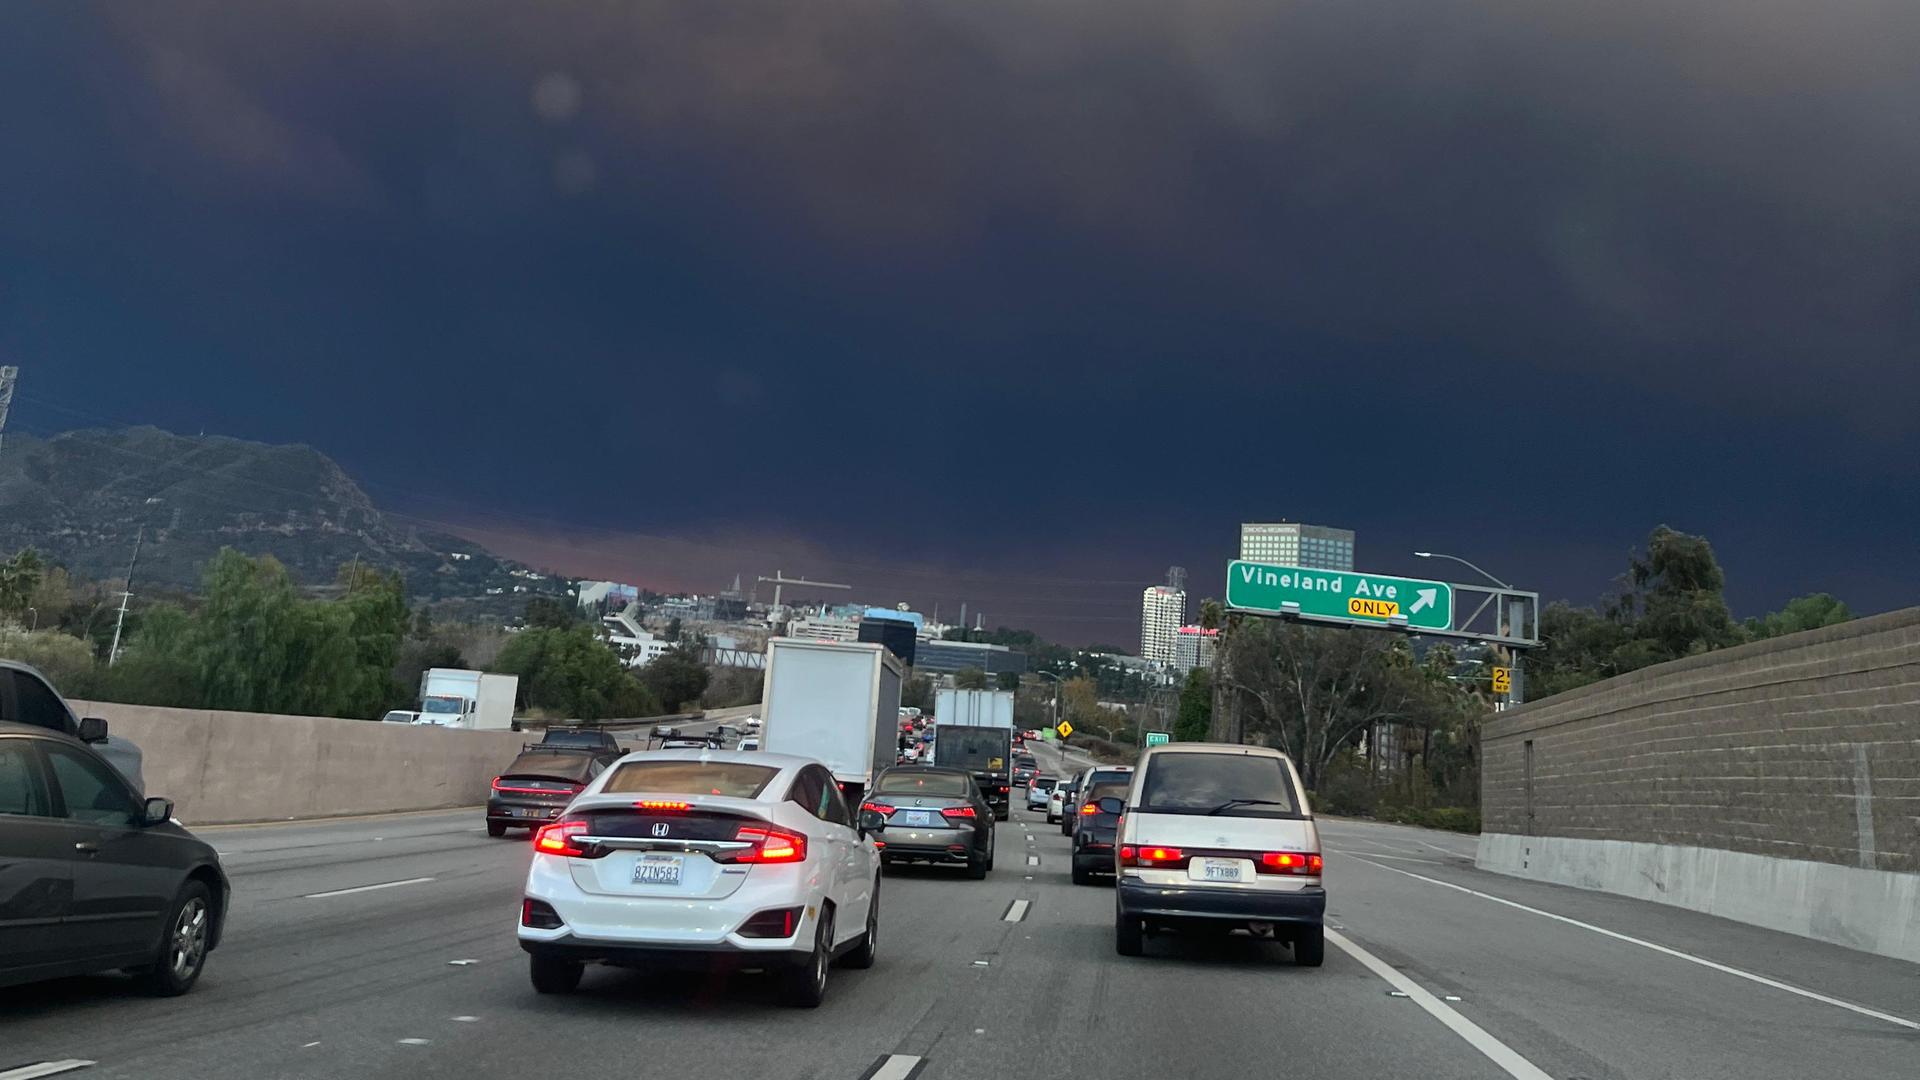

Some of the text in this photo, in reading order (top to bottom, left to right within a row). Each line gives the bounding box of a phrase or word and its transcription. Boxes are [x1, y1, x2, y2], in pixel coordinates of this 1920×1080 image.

[1241, 566, 1398, 599] Vineland Ave
[1350, 600, 1396, 615] ONLY
[634, 865, 679, 881] 8ZIN583
